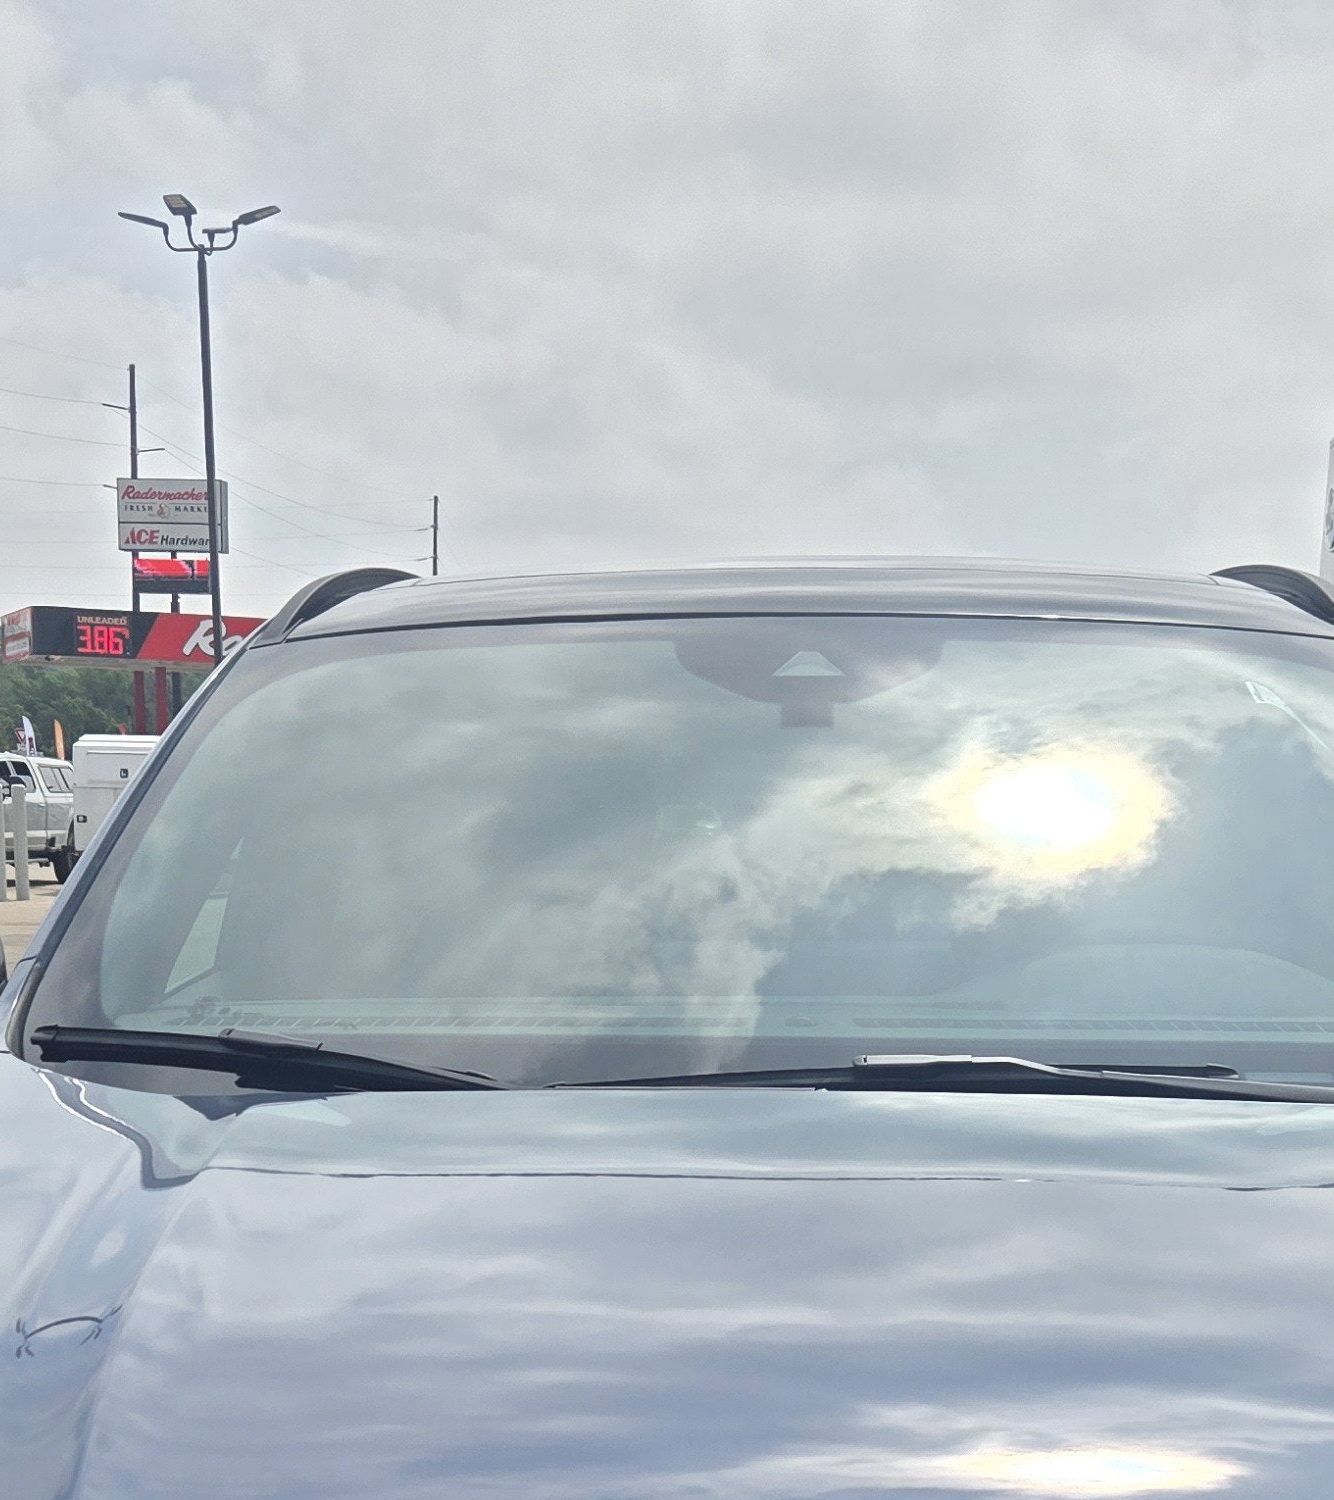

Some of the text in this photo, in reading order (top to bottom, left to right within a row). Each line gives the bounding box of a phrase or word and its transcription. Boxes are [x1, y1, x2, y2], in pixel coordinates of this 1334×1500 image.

[124, 504, 154, 512] FRESH
[124, 526, 209, 546] ACE Hardwar
[77, 615, 128, 625] UNLEADED
